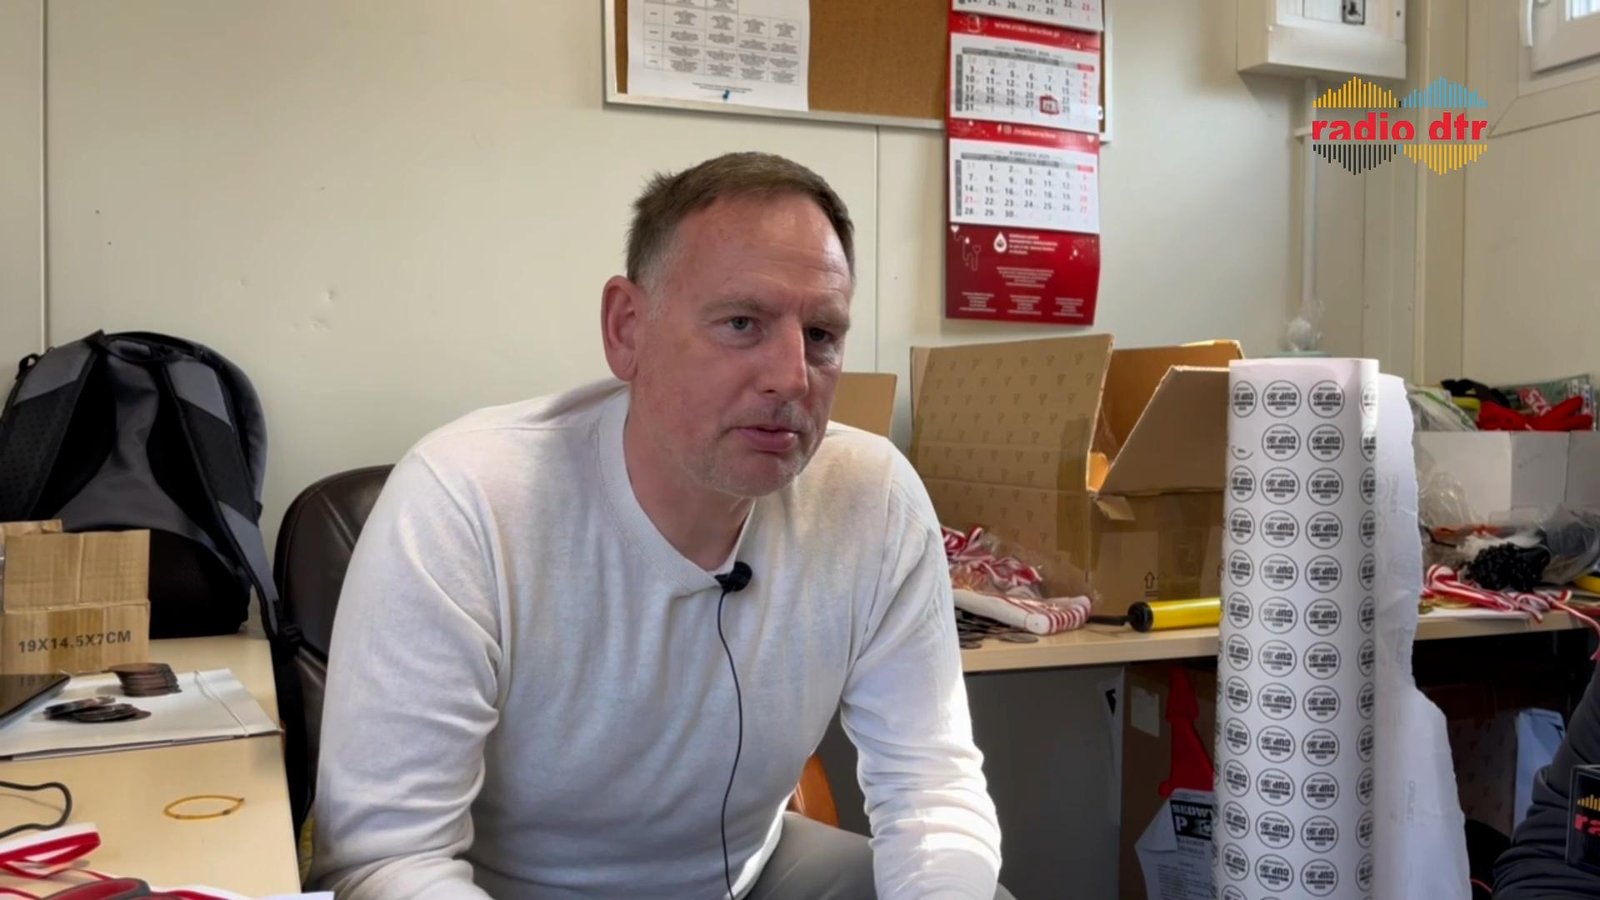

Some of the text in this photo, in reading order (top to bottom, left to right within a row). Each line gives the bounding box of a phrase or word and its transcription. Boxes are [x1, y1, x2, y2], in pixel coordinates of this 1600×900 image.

[1278, 392, 1297, 400] CUP
[1324, 392, 1342, 400] CUP
[1278, 436, 1296, 444] CUP
[1278, 480, 1296, 488] CUP
[1276, 523, 1294, 531] CUP
[1322, 524, 1339, 532] CUP
[1276, 566, 1294, 574] CUP
[1322, 567, 1338, 575] CUP
[1276, 609, 1294, 617] CUP
[1321, 610, 1338, 618] CUP
[18, 630, 131, 653] 19X14.5X7CM
[1274, 652, 1292, 660] CUP
[1320, 654, 1337, 662] CUP
[1274, 696, 1292, 704] CUP
[1320, 698, 1336, 706] CUP
[1273, 738, 1291, 746] CUP
[1272, 782, 1290, 790] CUP
[1272, 824, 1290, 832] CUP
[1318, 828, 1335, 836] CUP
[1272, 868, 1290, 876] CUP
[1318, 872, 1334, 880] CUP
